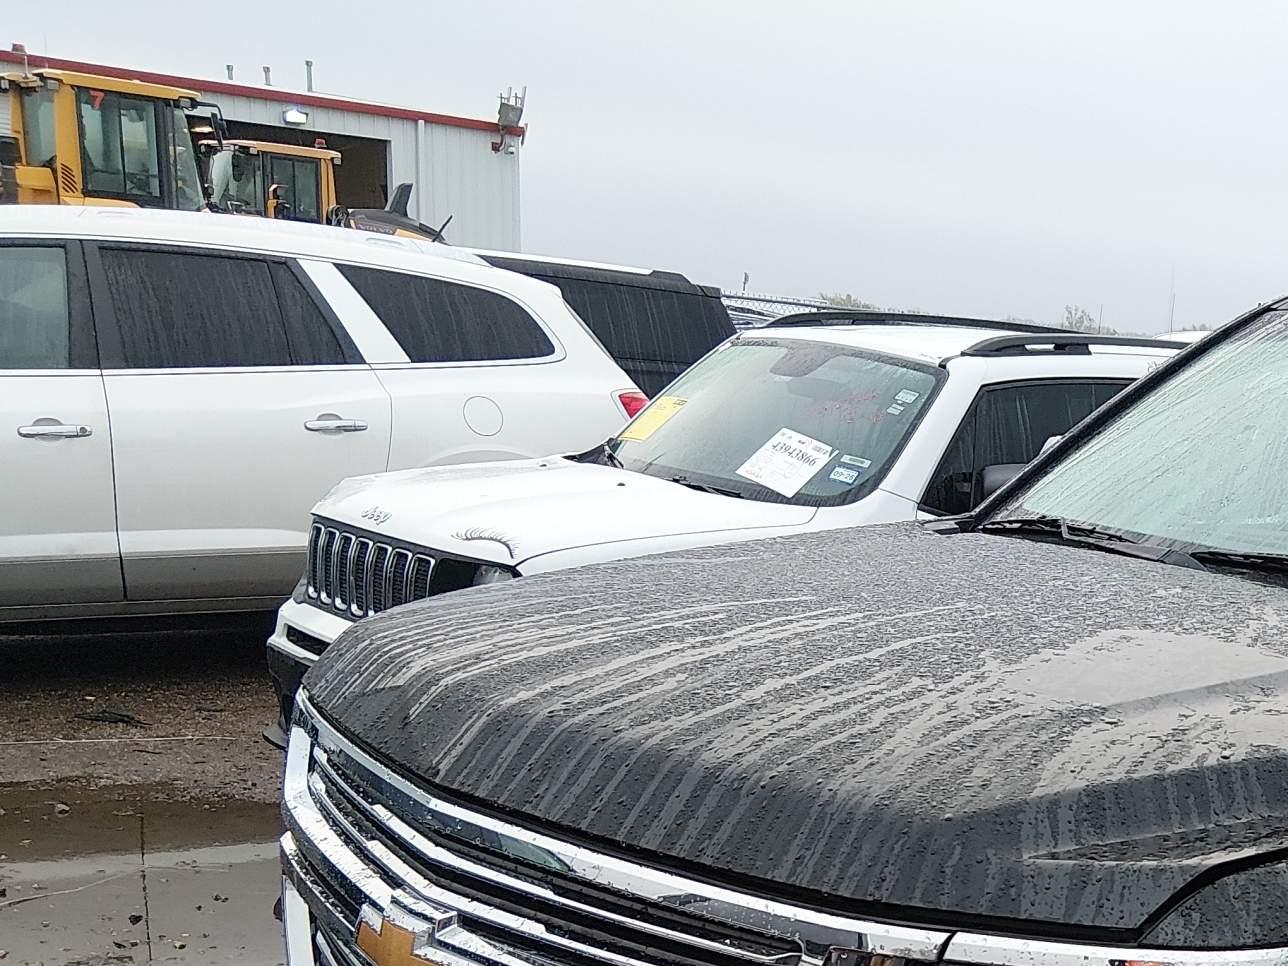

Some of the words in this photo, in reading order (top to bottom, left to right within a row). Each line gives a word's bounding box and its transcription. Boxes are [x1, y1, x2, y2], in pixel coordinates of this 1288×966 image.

[89, 90, 104, 109] 7
[771, 441, 819, 467] 43943866
[361, 504, 392, 526] Jeep
